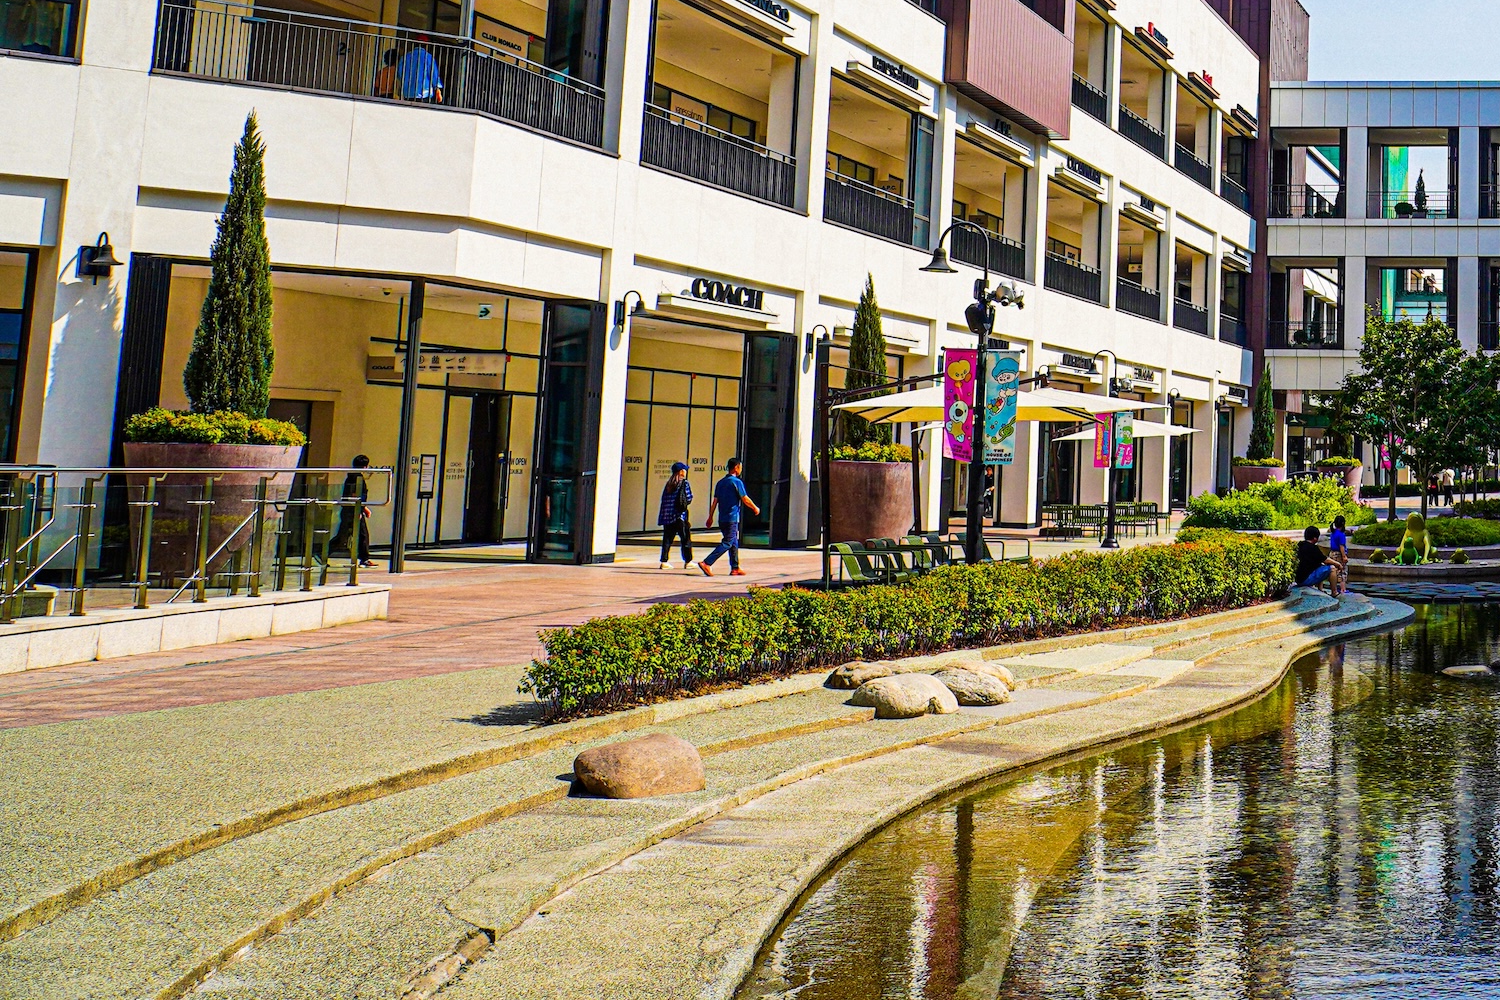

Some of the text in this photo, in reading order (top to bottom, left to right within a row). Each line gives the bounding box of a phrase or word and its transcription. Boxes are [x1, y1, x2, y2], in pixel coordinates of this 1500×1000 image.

[481, 31, 523, 52] CLUB MONACO
[691, 277, 765, 311] COACH
